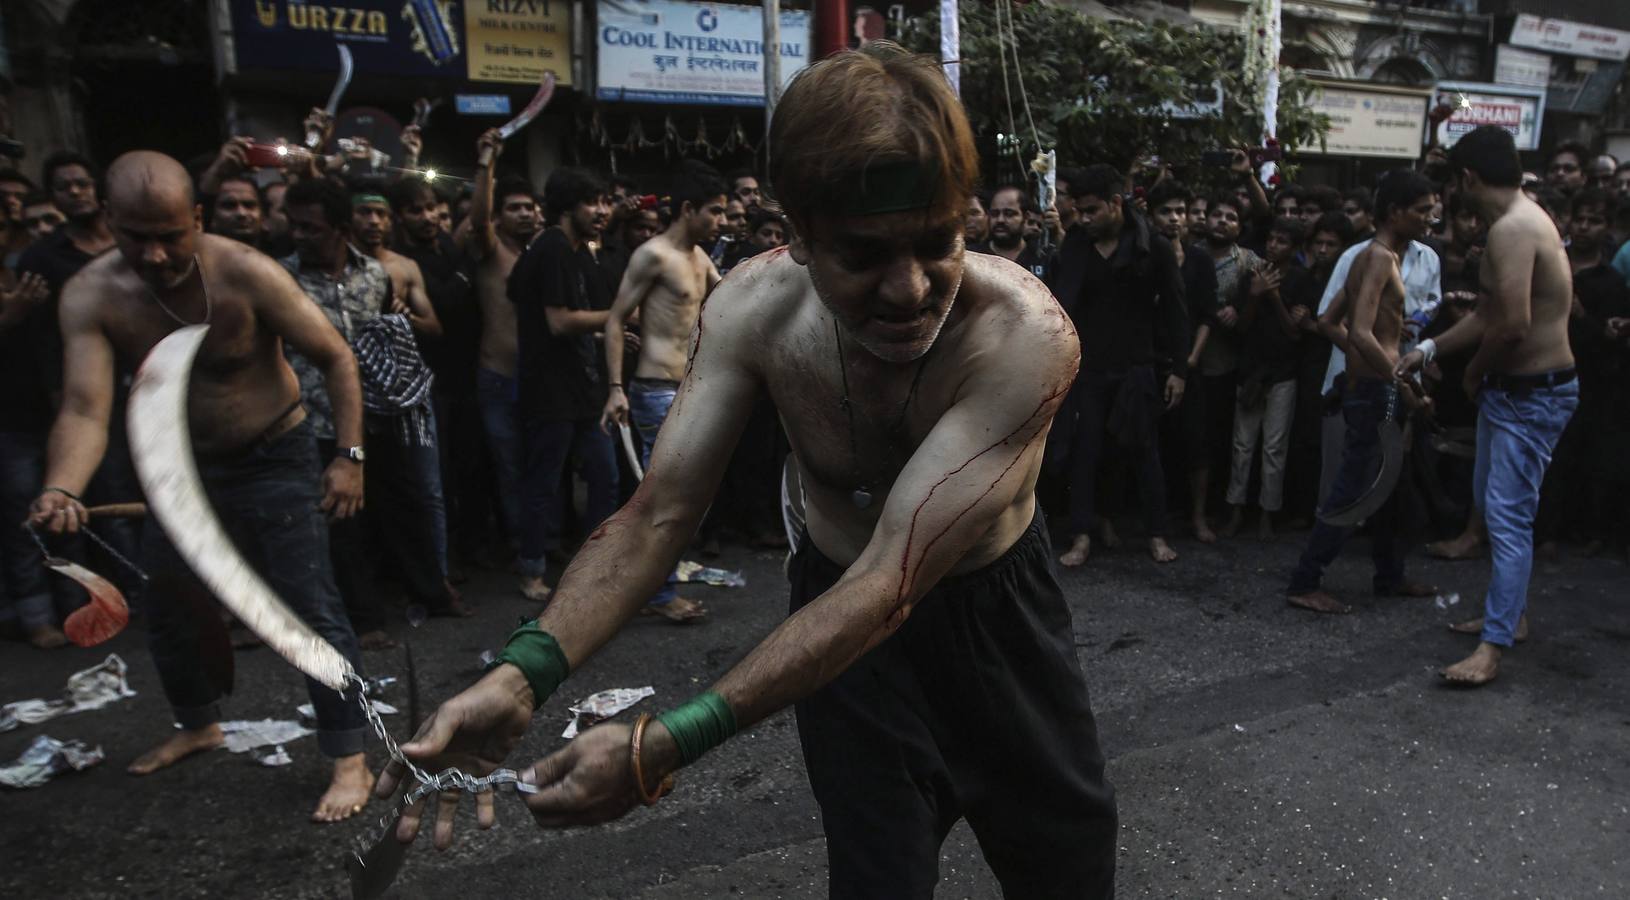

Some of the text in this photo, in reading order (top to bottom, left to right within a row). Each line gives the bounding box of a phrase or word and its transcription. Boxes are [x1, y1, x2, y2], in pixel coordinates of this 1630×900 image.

[287, 3, 387, 34] URZZA
[603, 26, 803, 57] COOL INTERNATIAL
